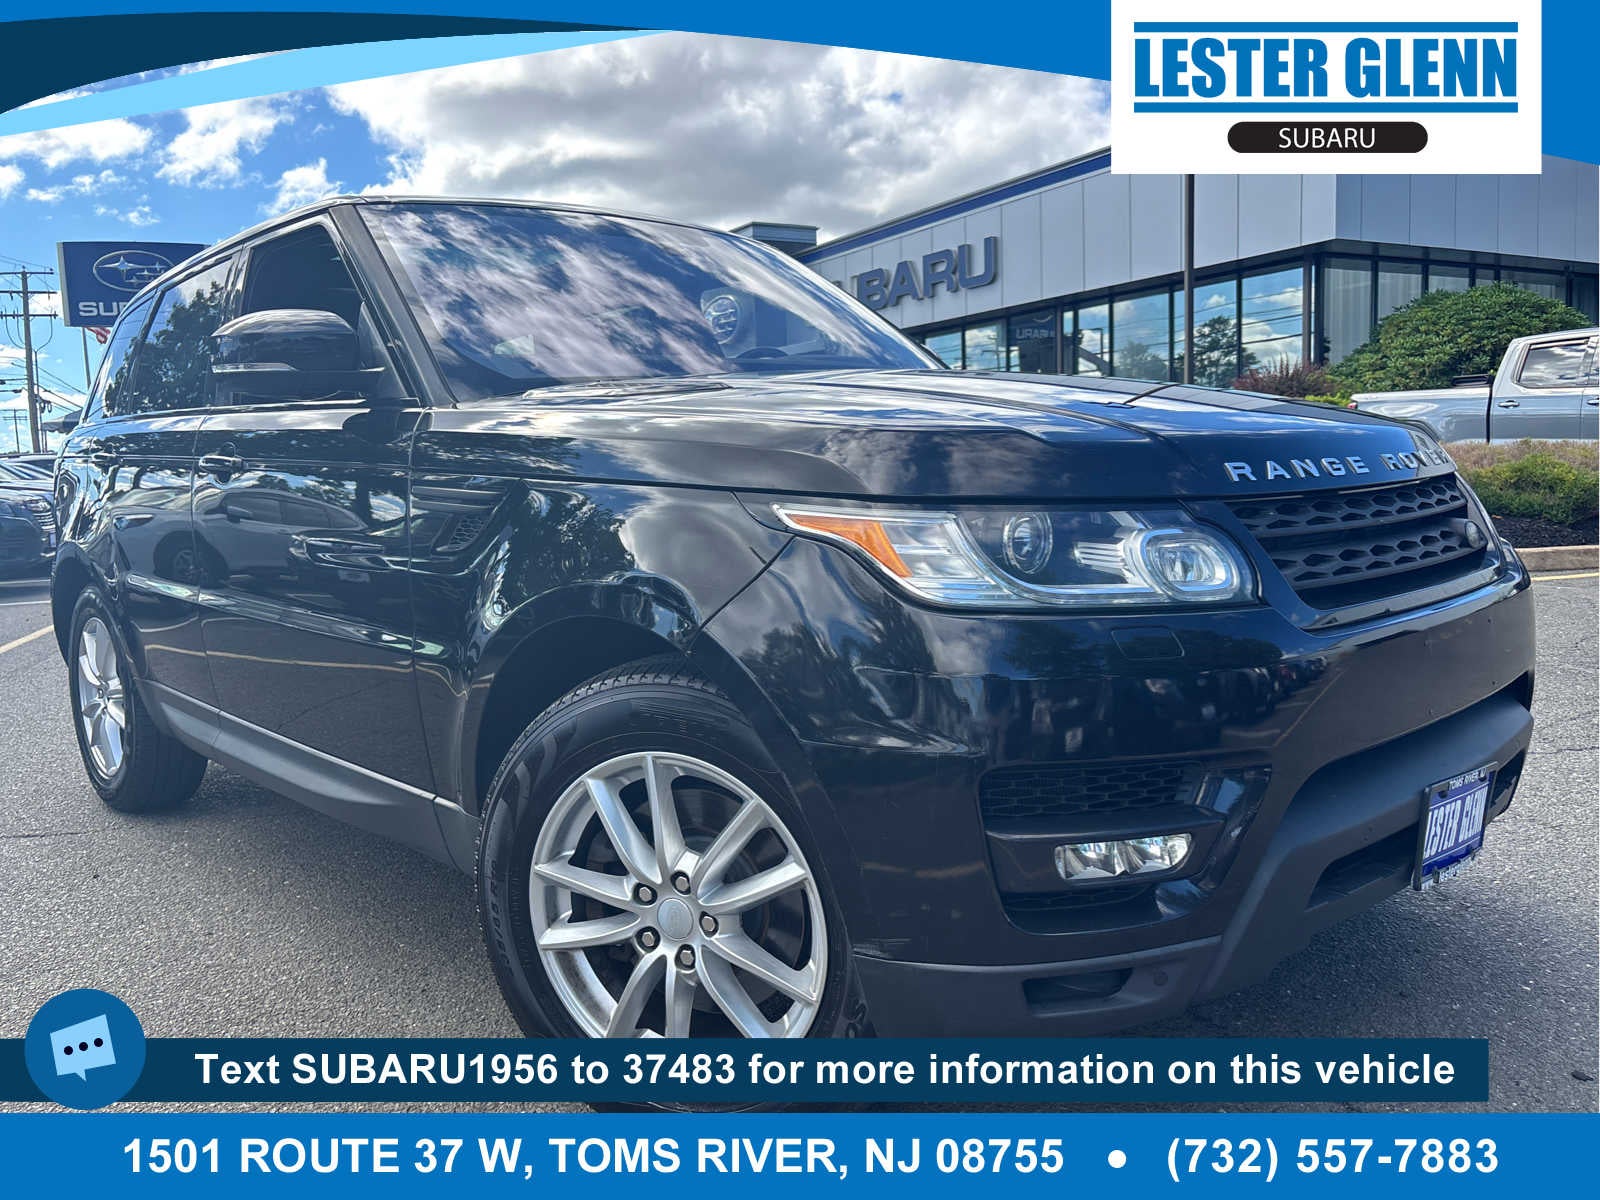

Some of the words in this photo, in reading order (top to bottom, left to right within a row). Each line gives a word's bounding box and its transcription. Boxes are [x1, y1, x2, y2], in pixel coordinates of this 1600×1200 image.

[832, 236, 999, 310] BARU
[1223, 456, 1371, 482] RANGE
[1379, 449, 1449, 472] ROVER
[1423, 799, 1461, 859] LESTER
[1458, 786, 1489, 843] GLENN
